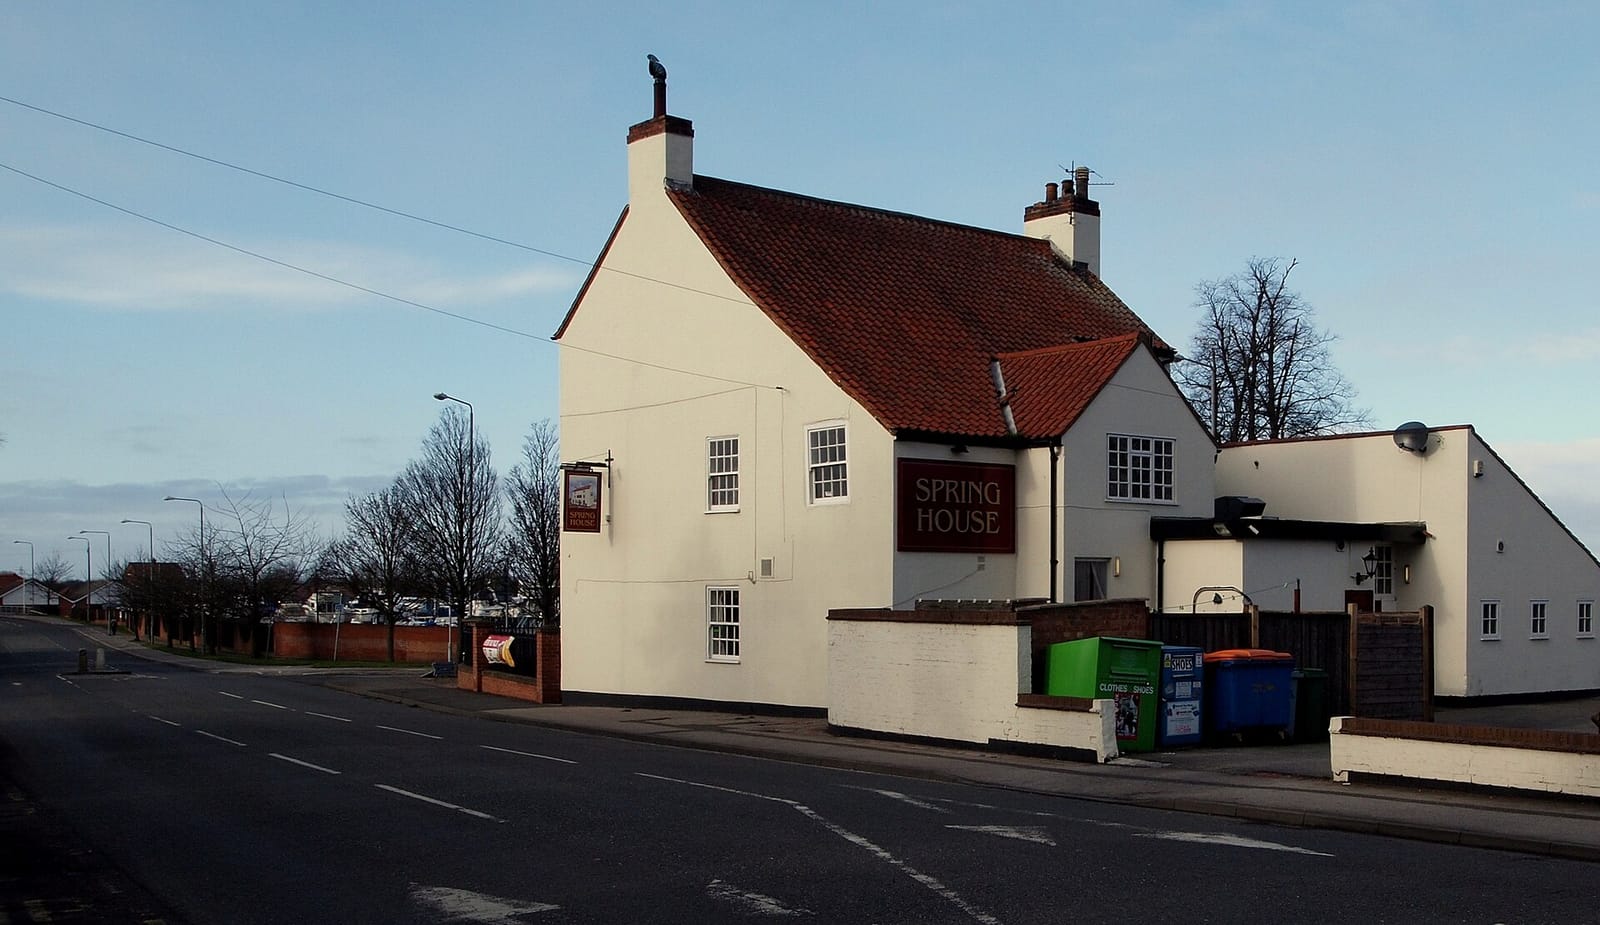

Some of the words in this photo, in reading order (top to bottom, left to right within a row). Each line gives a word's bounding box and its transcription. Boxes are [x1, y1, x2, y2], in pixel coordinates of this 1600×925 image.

[915, 478, 1001, 505] SPRING
[569, 511, 596, 520] SPRING
[916, 508, 1001, 534] HOUSE
[570, 519, 596, 527] HOUSE
[1171, 658, 1193, 672] SHOES
[1099, 682, 1128, 693] CLOTHES
[1133, 685, 1154, 695] SHOES
